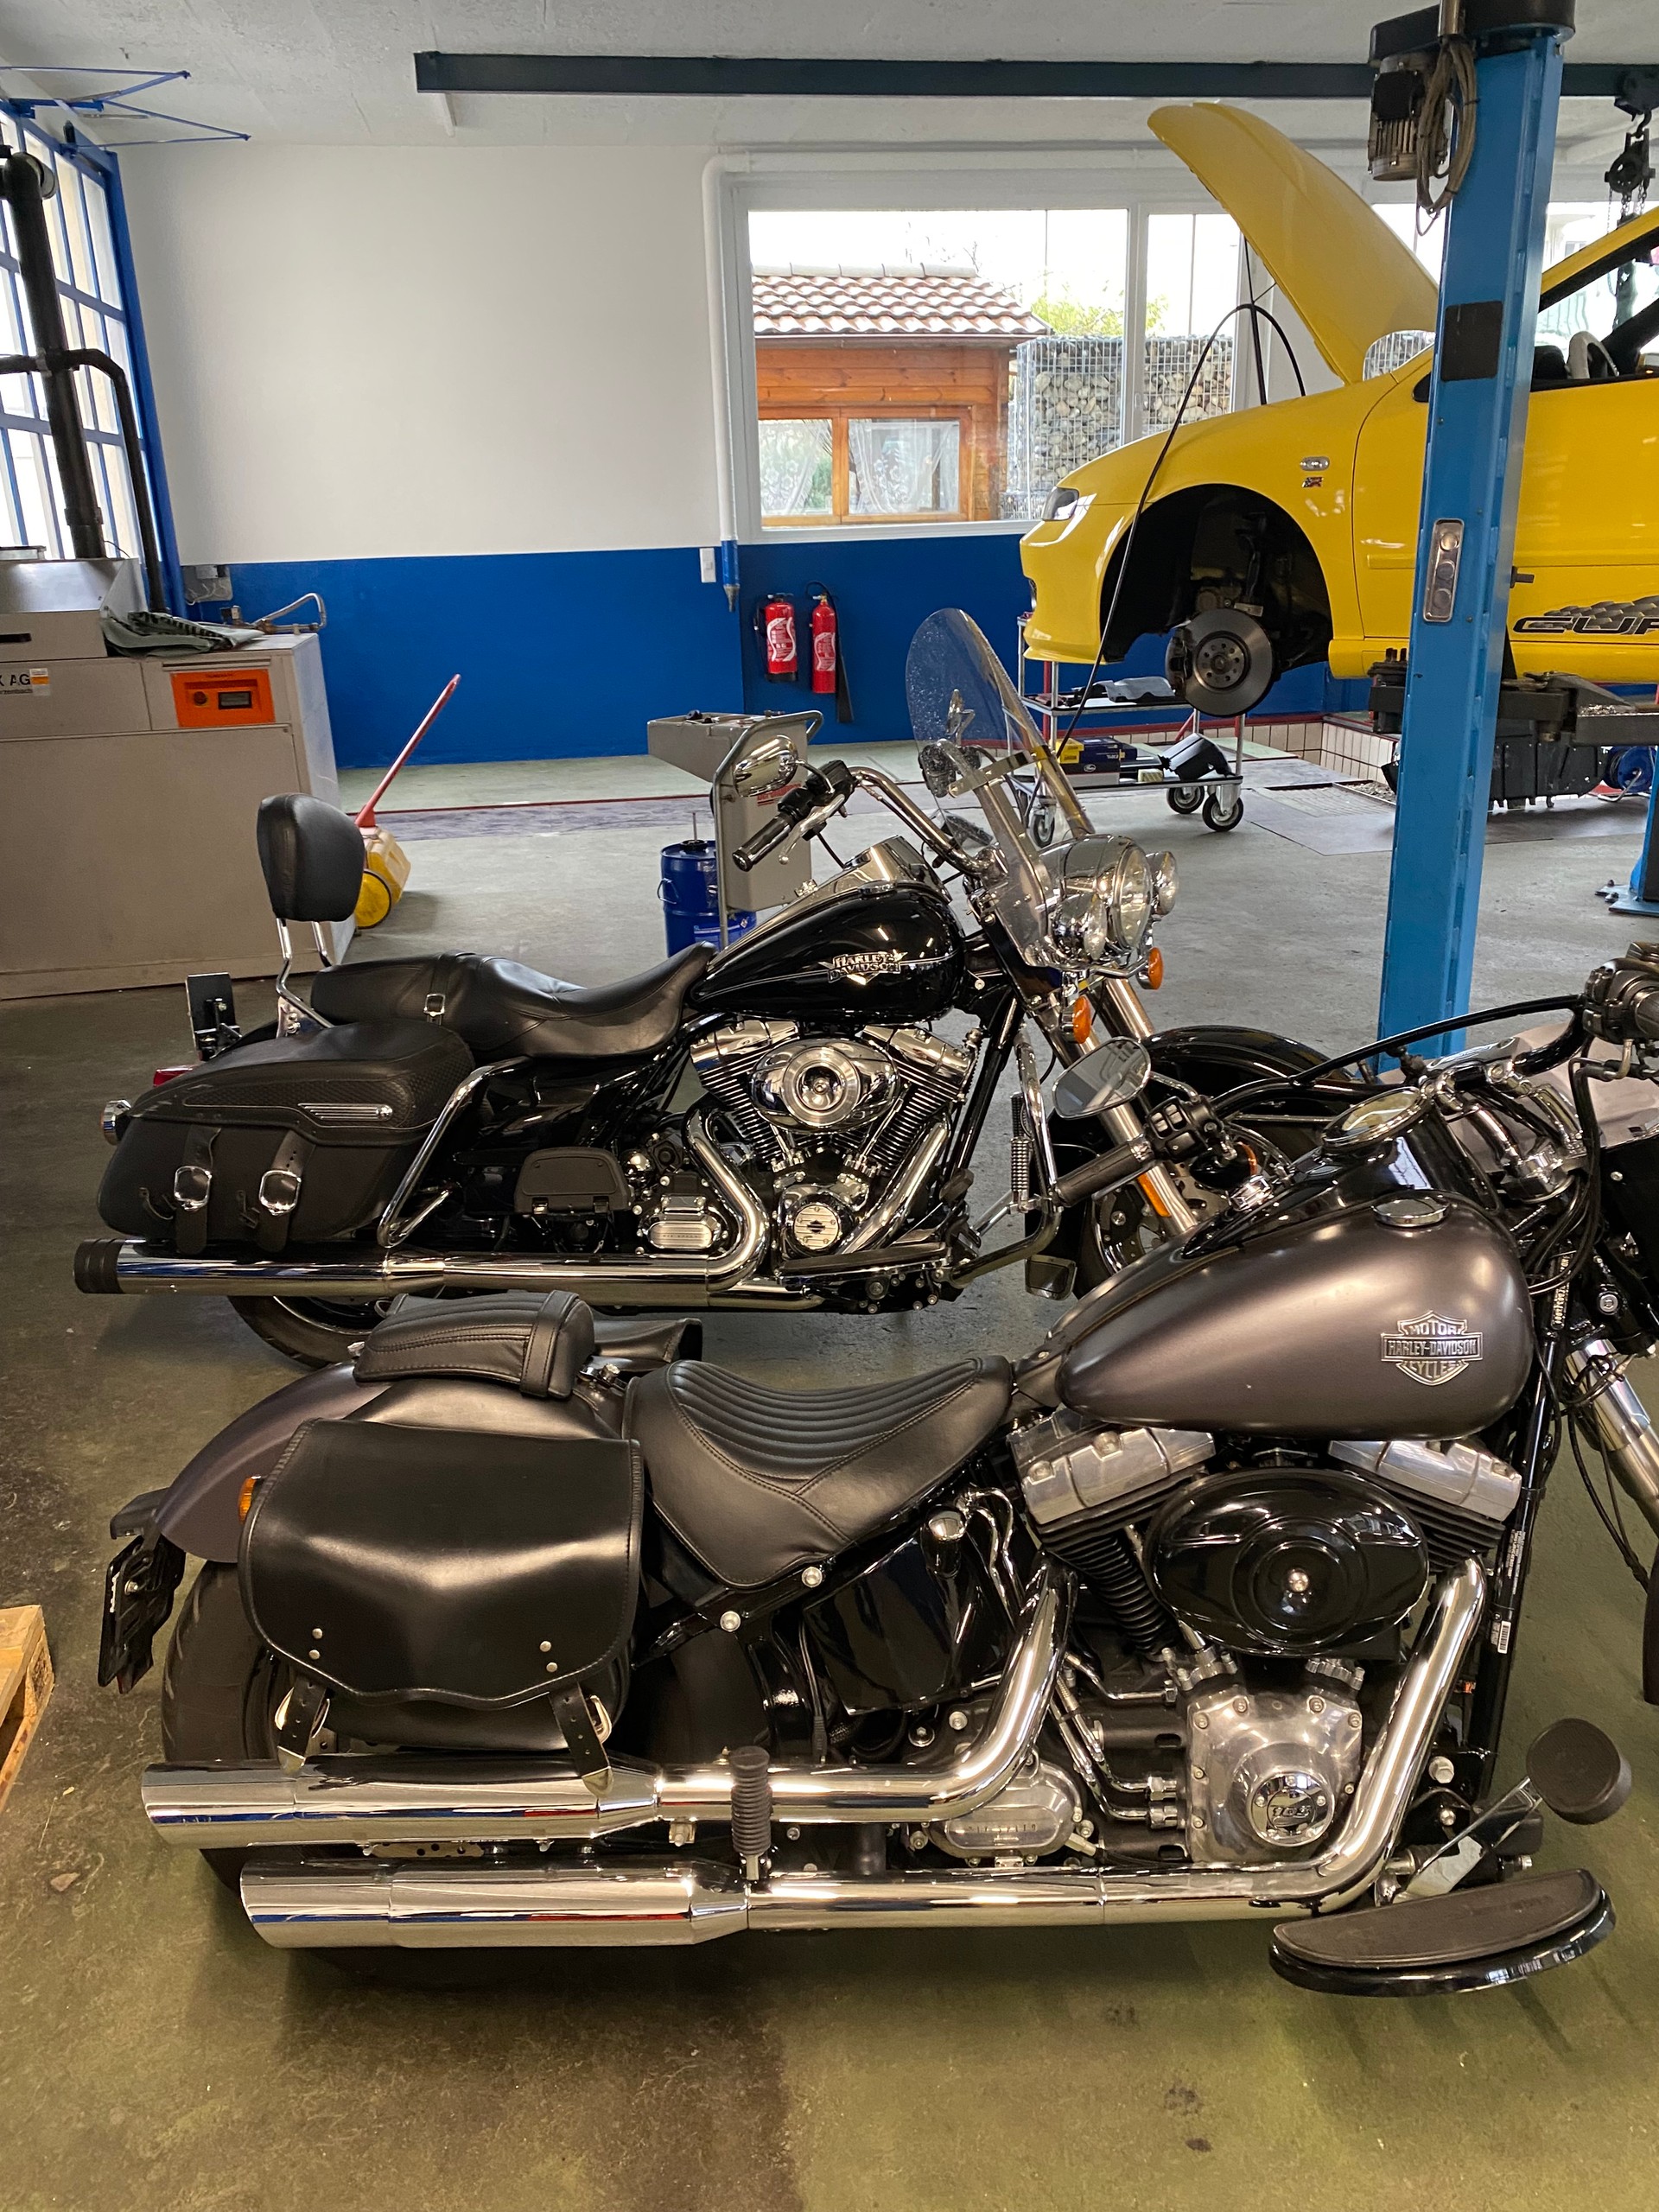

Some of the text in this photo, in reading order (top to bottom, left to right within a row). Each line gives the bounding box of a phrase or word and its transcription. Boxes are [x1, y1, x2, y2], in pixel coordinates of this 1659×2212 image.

[1408, 1319, 1459, 1336] MOTOR
[1388, 1339, 1477, 1357] HARLEY-DAVIDSON
[1409, 1360, 1458, 1379] CYCLES
